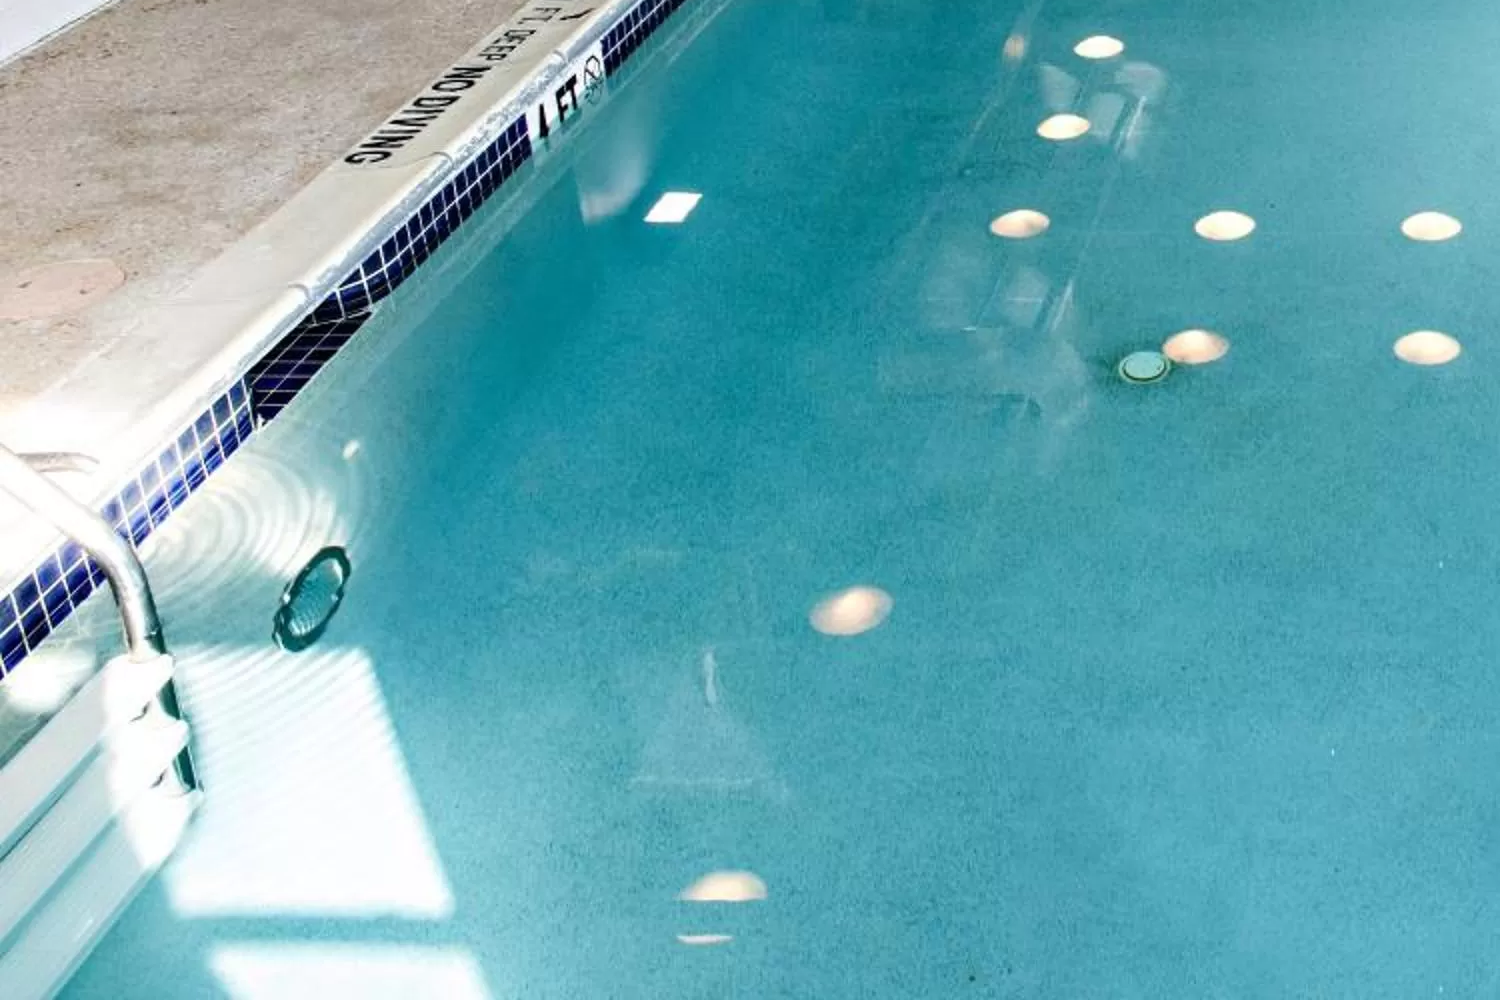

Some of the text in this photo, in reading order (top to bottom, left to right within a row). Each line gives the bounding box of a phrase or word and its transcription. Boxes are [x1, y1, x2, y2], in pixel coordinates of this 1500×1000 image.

[478, 29, 537, 61] DEEP
[431, 66, 492, 93] NO
[556, 74, 578, 123] FT
[344, 96, 461, 165] DIVING
